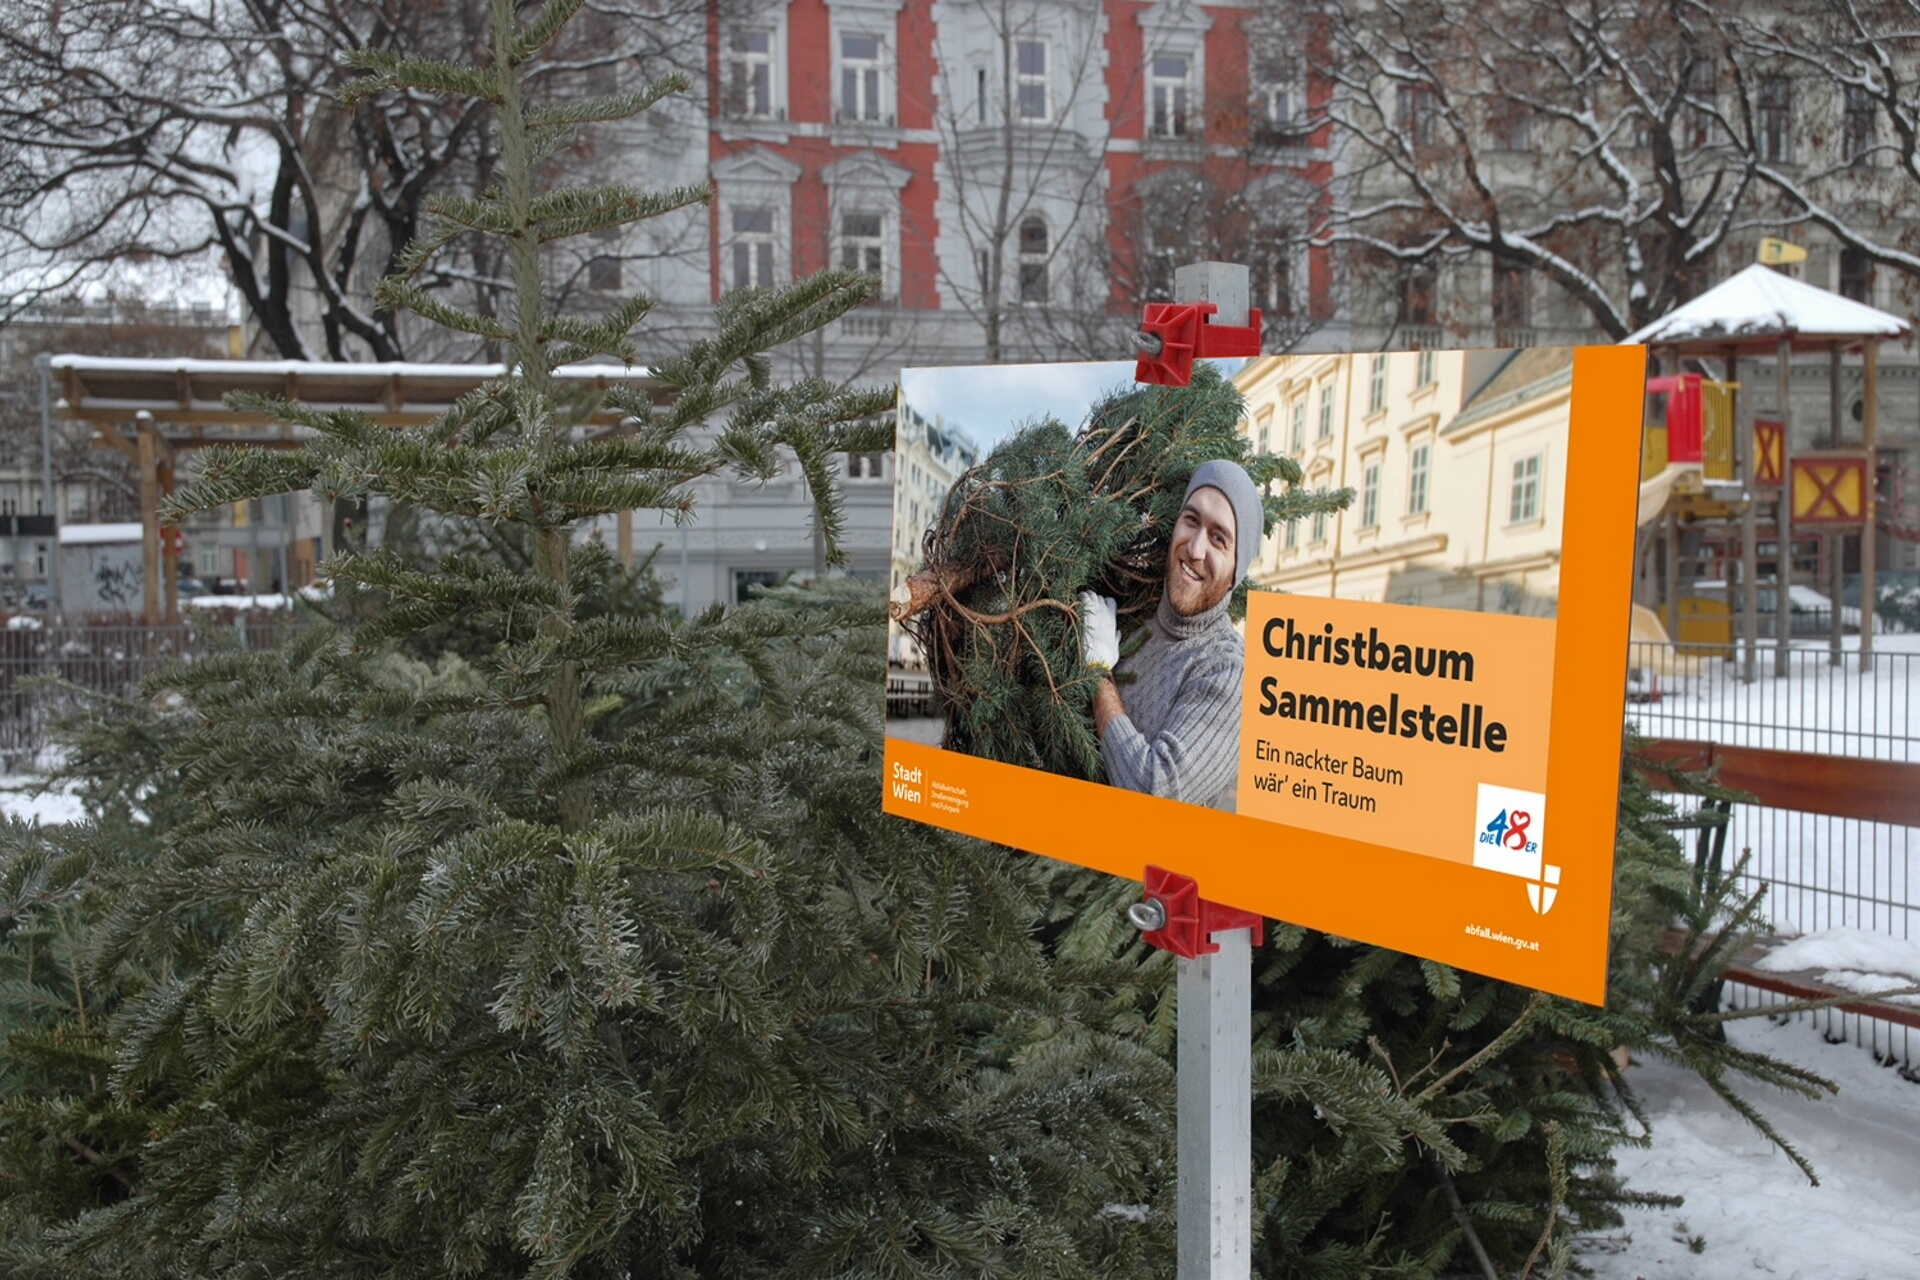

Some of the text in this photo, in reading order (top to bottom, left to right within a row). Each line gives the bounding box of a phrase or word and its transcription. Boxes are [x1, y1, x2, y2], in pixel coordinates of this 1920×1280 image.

[1262, 617, 1474, 682] Christbaum
[1259, 676, 1508, 752] Sammelstelle
[893, 761, 922, 784] Stadt
[1256, 739, 1403, 786] Ein nackter Baum
[892, 781, 921, 804] Wien
[1292, 781, 1317, 801] ein
[1322, 782, 1376, 813] Traum
[1479, 832, 1495, 845] DIE
[1464, 923, 1540, 952] abfall.wien.gv.at
